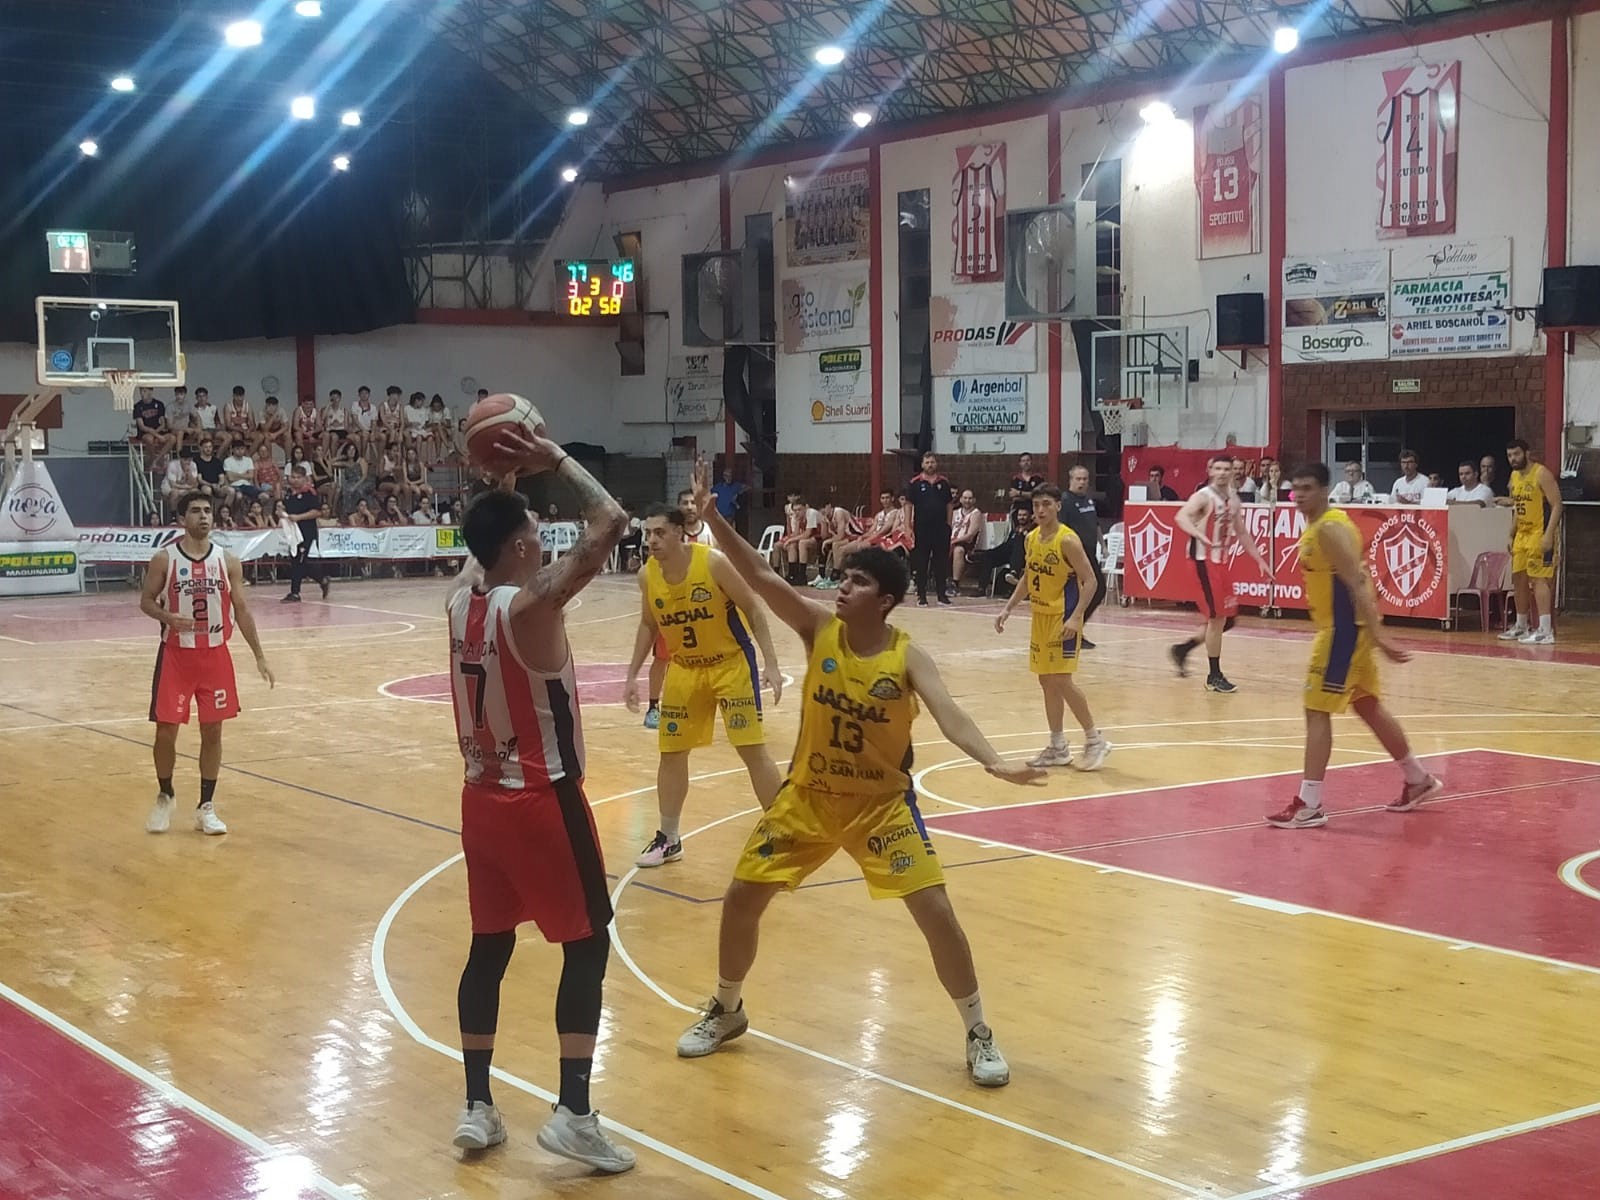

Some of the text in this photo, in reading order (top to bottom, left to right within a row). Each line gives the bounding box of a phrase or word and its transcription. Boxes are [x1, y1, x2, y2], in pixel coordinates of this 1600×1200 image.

[1406, 126, 1423, 158] 4
[1212, 167, 1239, 202] 13
[971, 193, 981, 221] 5
[1208, 210, 1244, 226] SPORTIVO
[64, 248, 87, 270] 17
[567, 263, 634, 282] 77 46
[590, 277, 600, 296] 3
[1394, 280, 1463, 295] FARMACIA
[570, 296, 621, 315] 02 58
[933, 326, 996, 343] PRODAS
[1406, 320, 1433, 331] ARIEL
[1302, 335, 1364, 353] Bosagro
[970, 376, 1022, 397] Argenbal
[825, 403, 871, 416] Shell Suardi
[1400, 513, 1415, 523] DEL
[79, 533, 152, 544] PRODAS
[1369, 515, 1398, 560] ASOCIADOS
[1417, 519, 1436, 539] CLUB
[0, 553, 75, 568] POLETTO
[1431, 540, 1443, 589] SPORTIVO
[6, 567, 69, 577] MAQUINARIAS
[173, 578, 225, 594] SPORTIVO
[1032, 574, 1041, 591] 4
[1232, 582, 1302, 599] SPORTIVO
[1375, 579, 1403, 607] MUTUAL
[1405, 588, 1433, 608] SUARDI
[192, 598, 209, 621] 2
[660, 606, 714, 627] JACHAL
[683, 626, 697, 649] 3
[214, 688, 228, 709] 2
[460, 662, 487, 729] 7
[813, 684, 891, 724] JACHAL
[829, 715, 864, 754] 13
[829, 763, 885, 782] SAN JUAN
